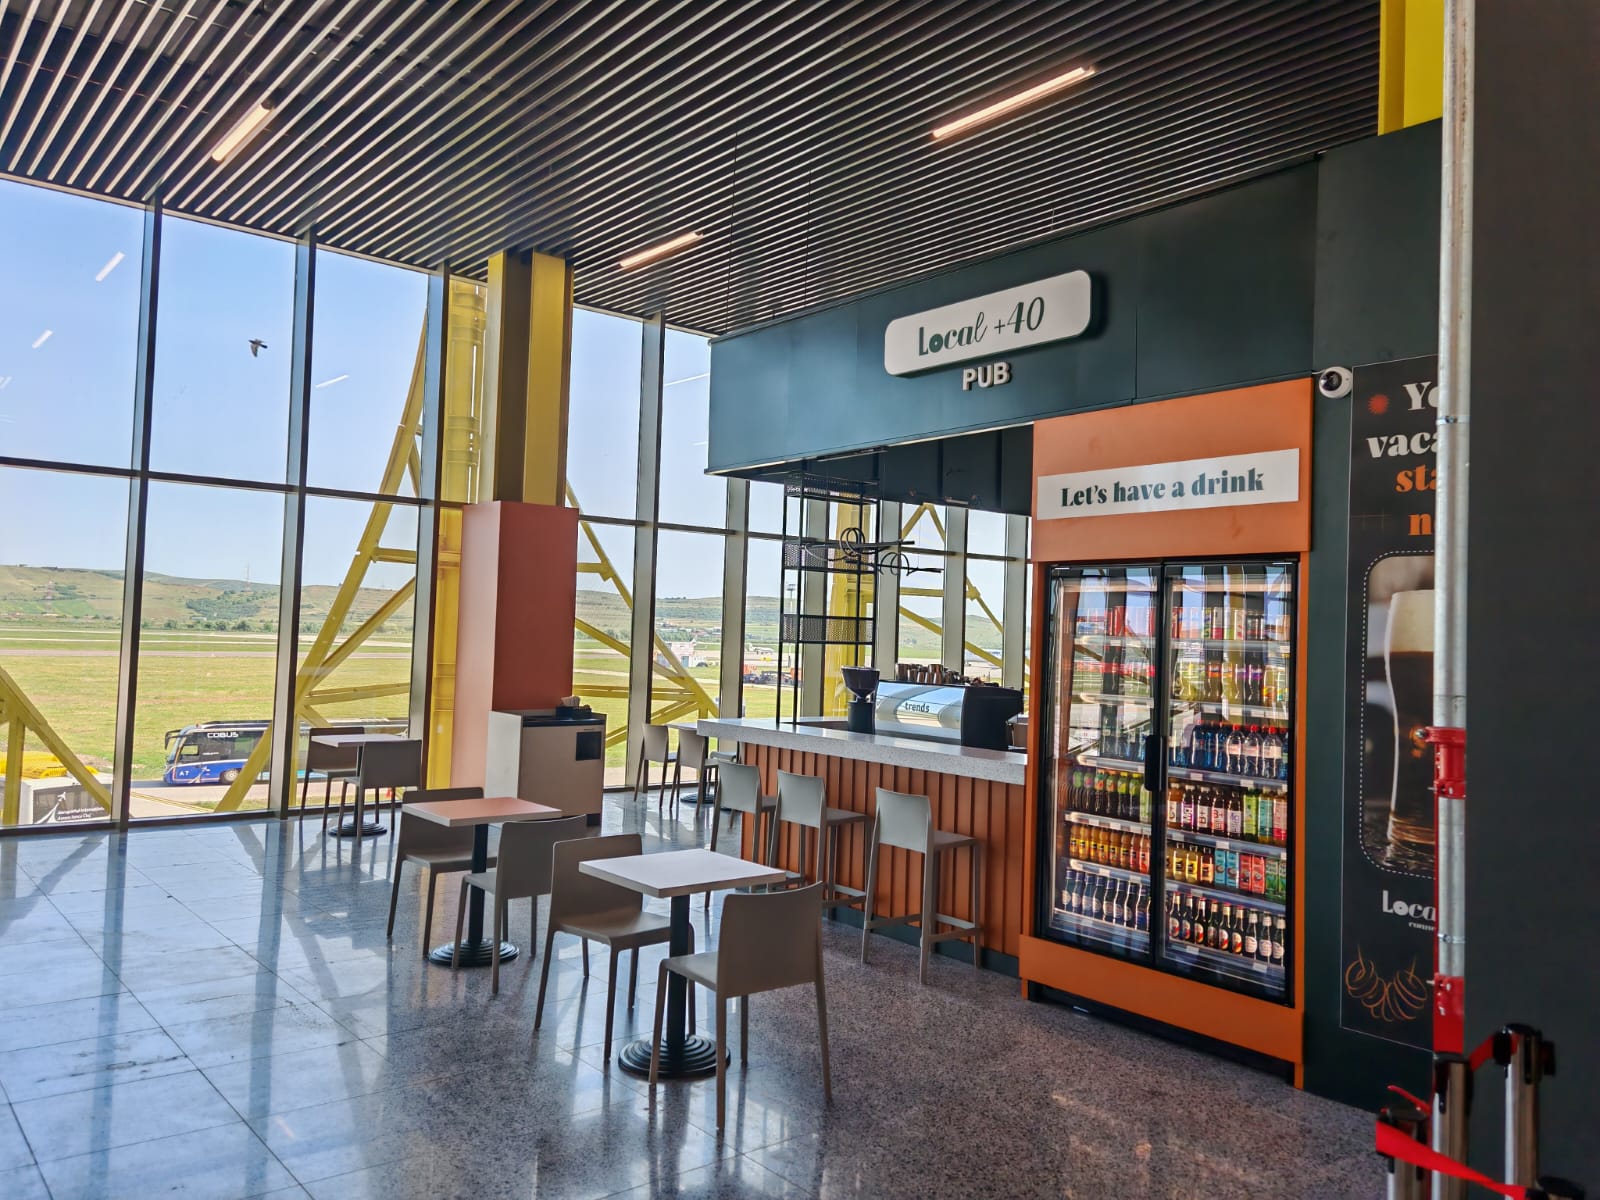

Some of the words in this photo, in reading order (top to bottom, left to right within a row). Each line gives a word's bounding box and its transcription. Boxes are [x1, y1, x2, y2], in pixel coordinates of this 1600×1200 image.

[918, 311, 988, 356] Local
[994, 296, 1046, 335] +40
[962, 361, 1012, 391] PUB
[1060, 484, 1107, 507] Let's
[1113, 480, 1166, 503] have
[1171, 480, 1186, 498] a
[1191, 467, 1265, 496] drink
[904, 701, 930, 714] trends
[207, 731, 239, 739] COBUS
